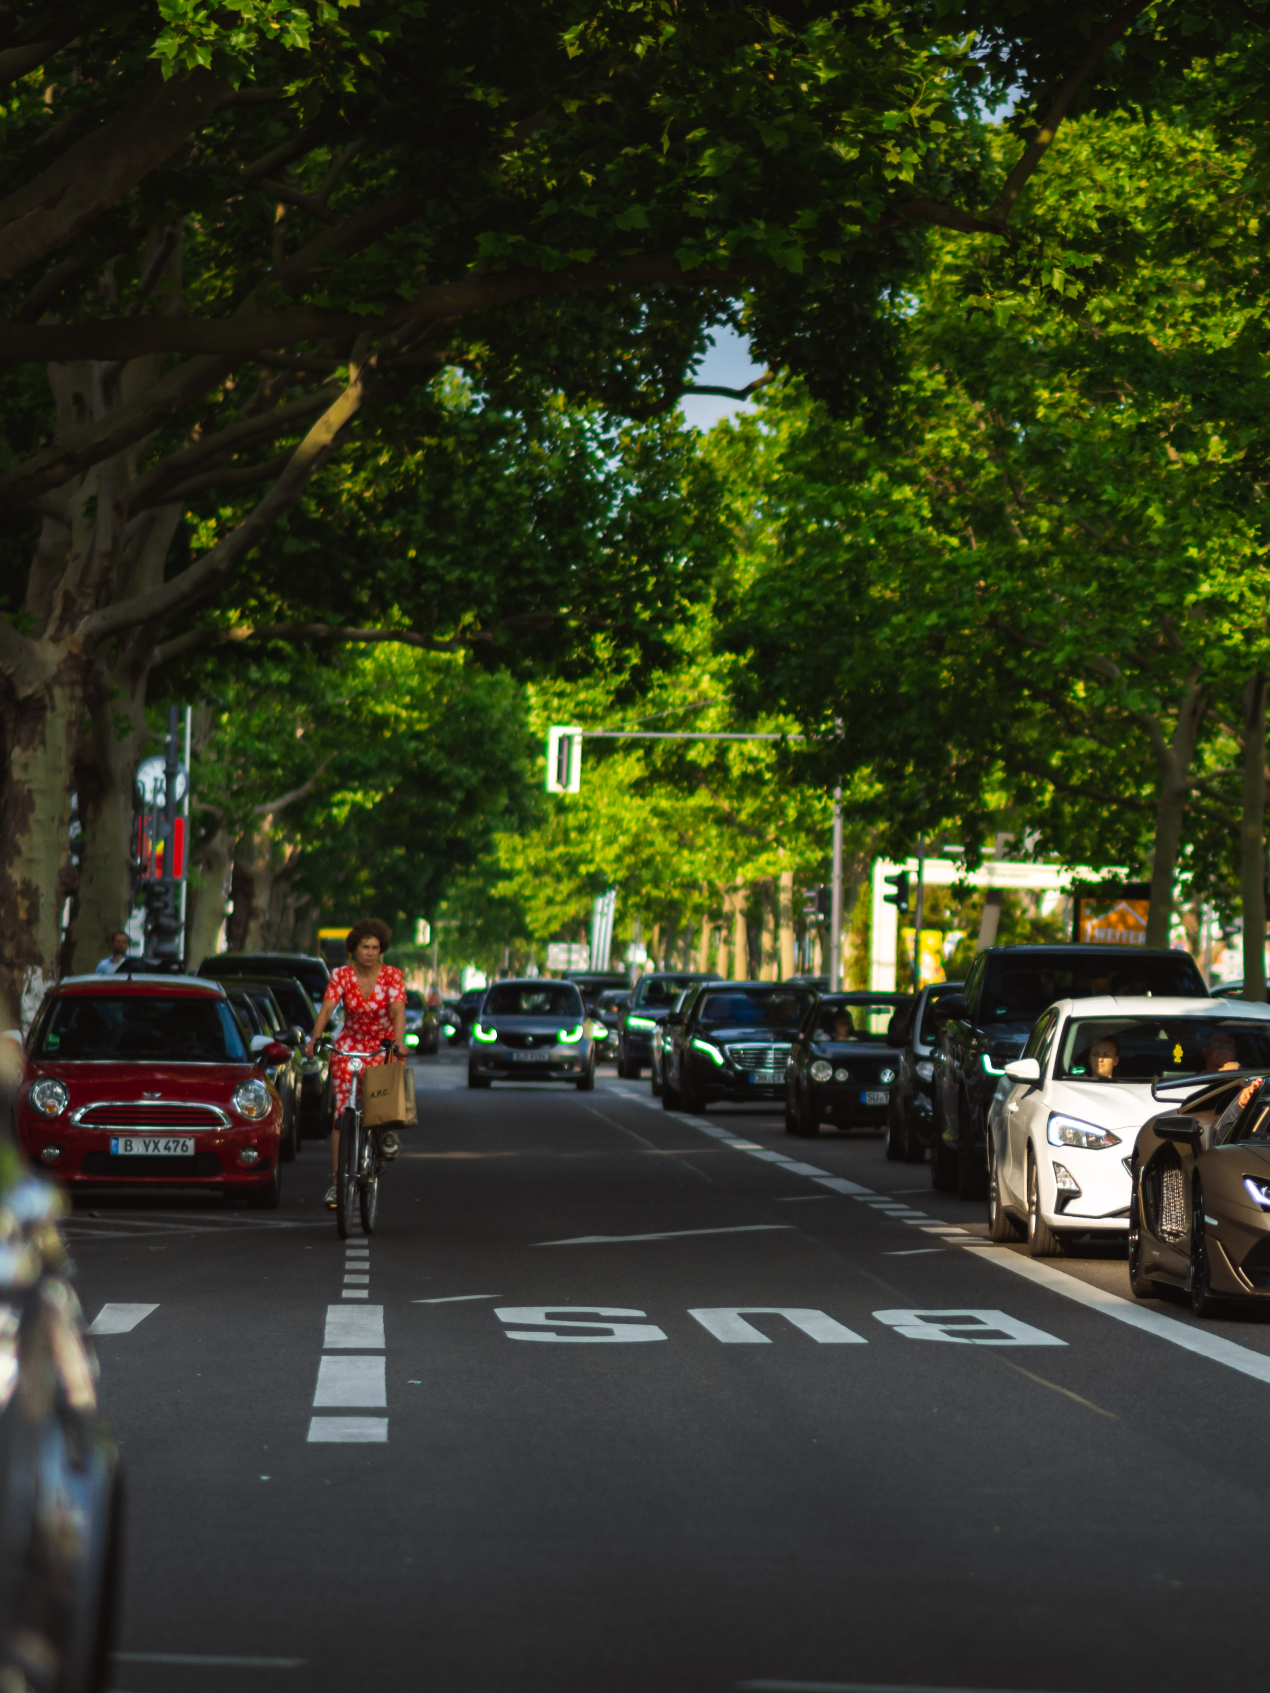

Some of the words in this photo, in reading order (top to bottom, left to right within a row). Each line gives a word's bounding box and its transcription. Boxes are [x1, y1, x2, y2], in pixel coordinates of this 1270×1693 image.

[124, 1139, 134, 1153] B
[143, 1139, 160, 1153] YX
[163, 1139, 189, 1153] 476
[493, 1306, 1070, 1345] BUS
